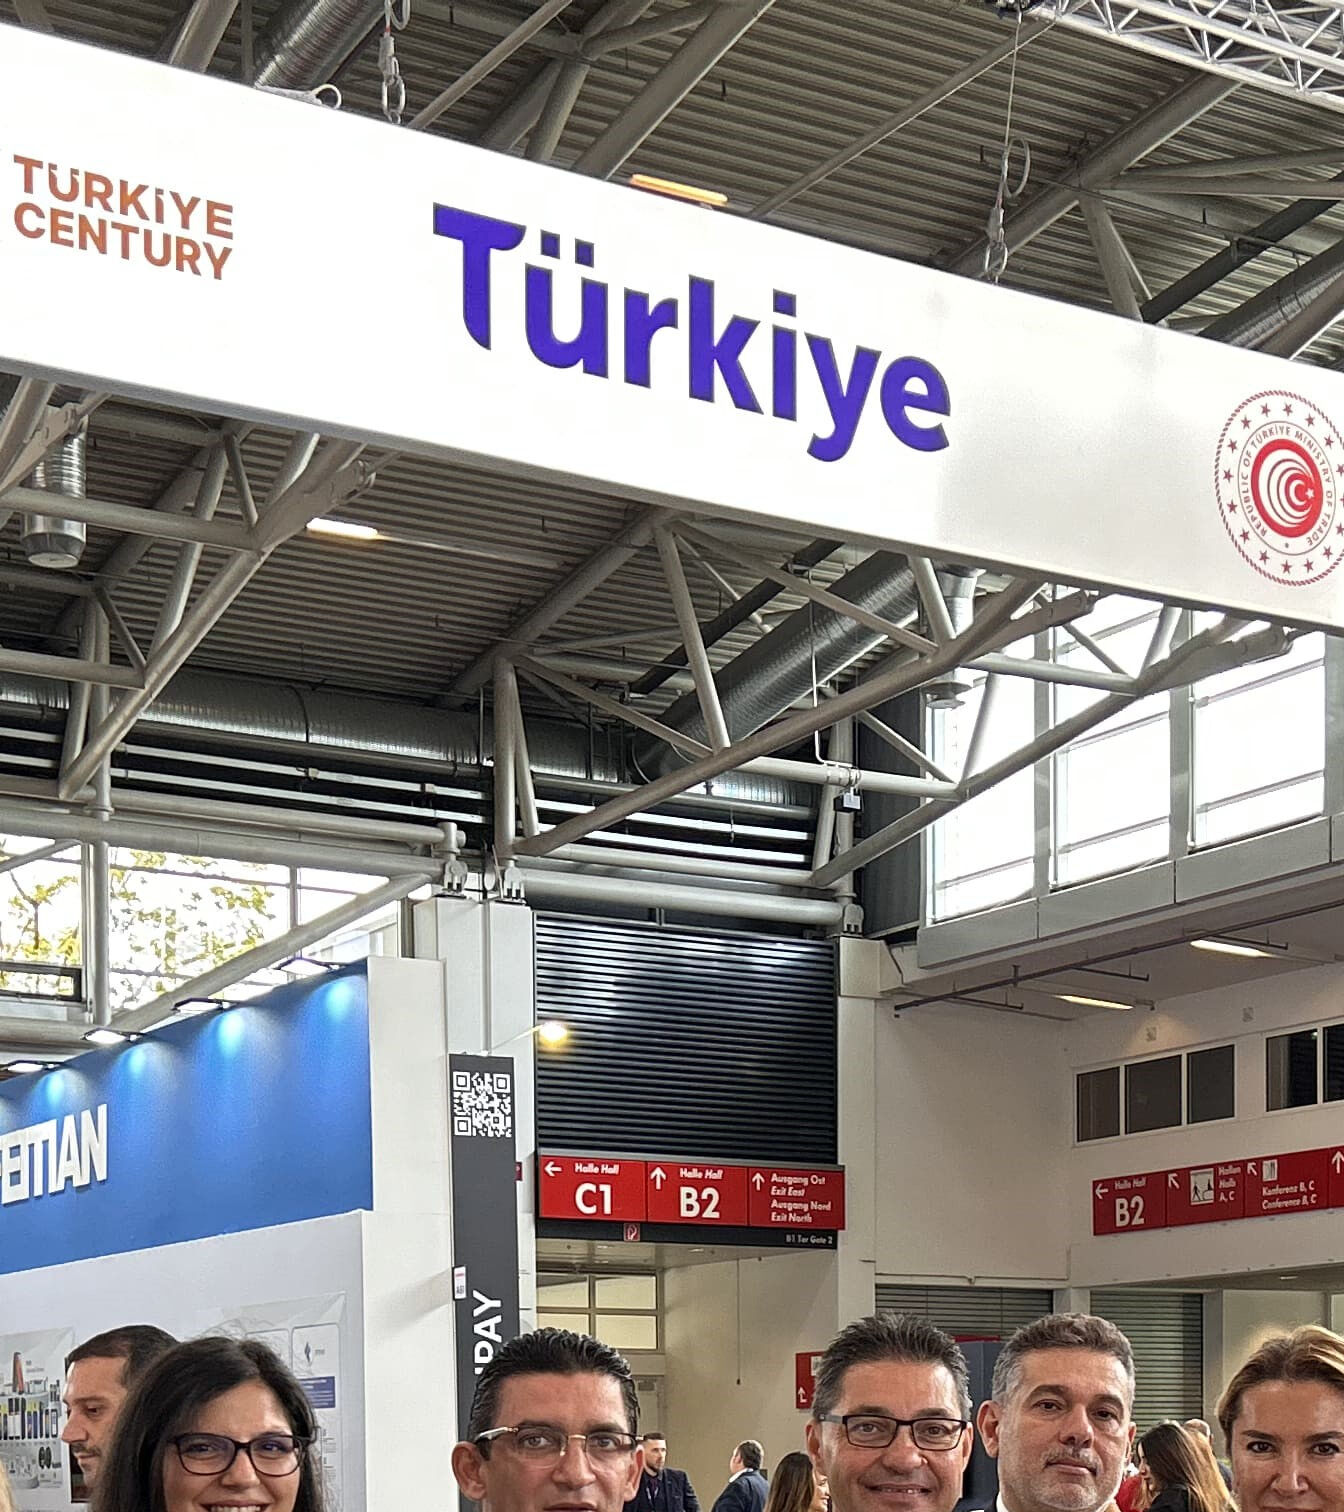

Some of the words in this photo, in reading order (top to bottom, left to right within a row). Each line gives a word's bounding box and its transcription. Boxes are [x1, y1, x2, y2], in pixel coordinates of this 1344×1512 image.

[13, 202, 233, 280] CENTURY
[433, 203, 951, 462] Türkiye
[1243, 450, 1254, 468] OF
[1294, 431, 1332, 483] MINISTRY
[1241, 472, 1268, 537] REPUBLIC
[1307, 511, 1331, 546] TRADE
[575, 1163, 598, 1174] Halle
[600, 1164, 619, 1175] Hall
[680, 1168, 703, 1179] Halle
[705, 1169, 723, 1180] Hall
[771, 1173, 808, 1186] Ausgang
[810, 1175, 825, 1184] Ost
[575, 1183, 612, 1214] C1
[680, 1187, 720, 1218] B2
[771, 1186, 786, 1195] Exit
[788, 1187, 805, 1196] East
[771, 1199, 808, 1211] Ausgang
[810, 1201, 831, 1210] Nord
[771, 1212, 787, 1221] Exit
[789, 1213, 812, 1222] North
[1115, 1196, 1145, 1227] B2
[473, 1290, 502, 1374] PAY
